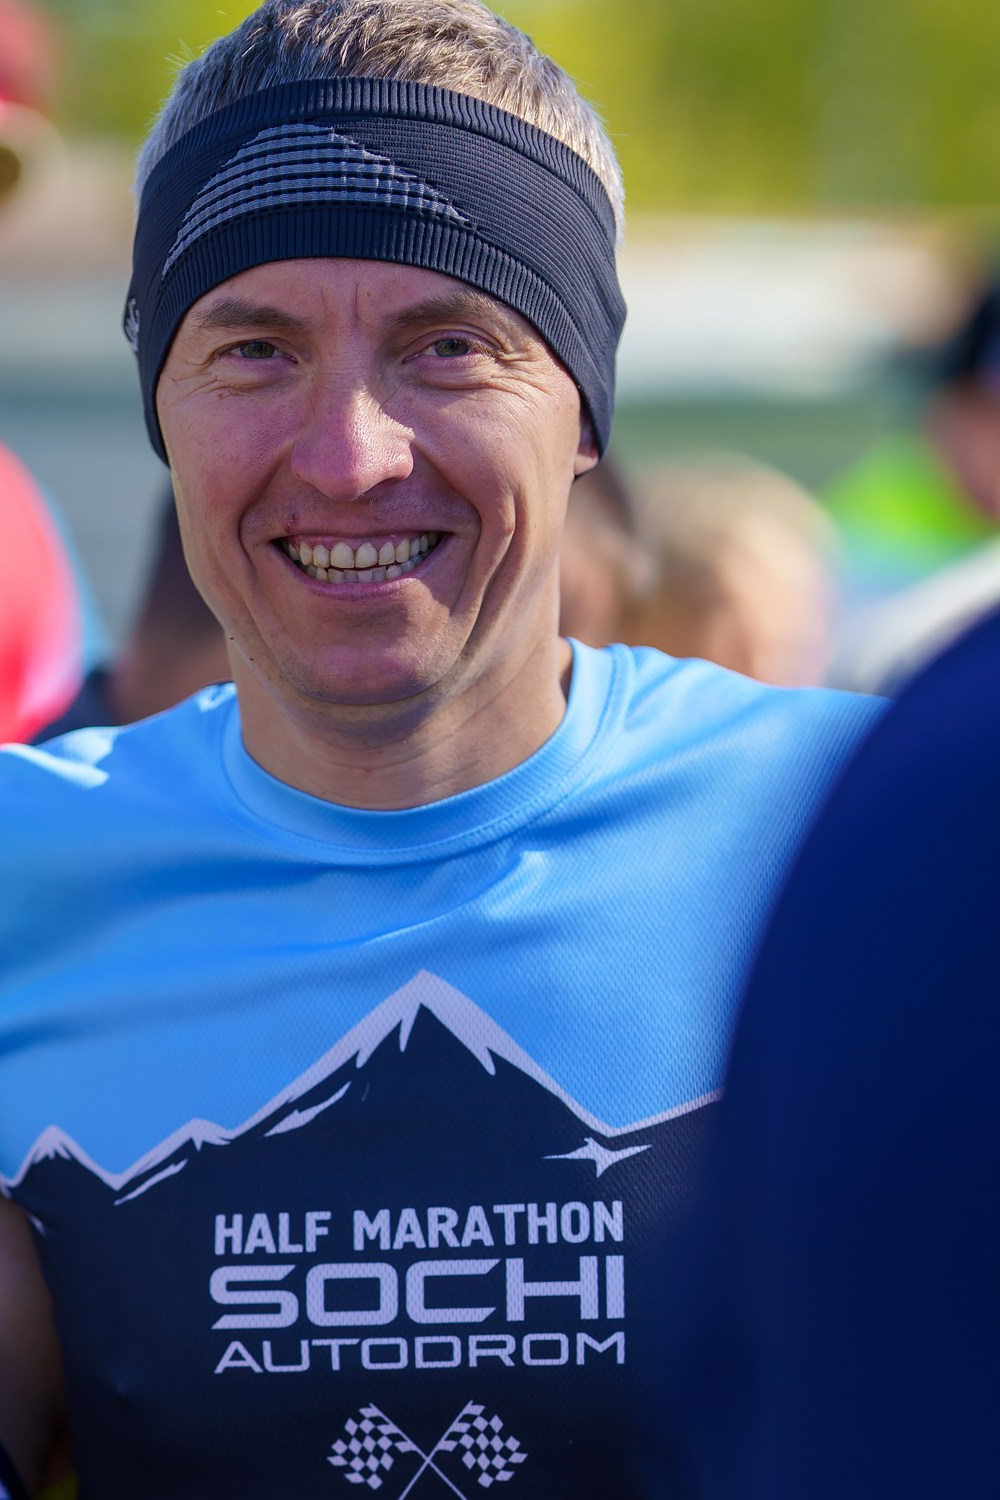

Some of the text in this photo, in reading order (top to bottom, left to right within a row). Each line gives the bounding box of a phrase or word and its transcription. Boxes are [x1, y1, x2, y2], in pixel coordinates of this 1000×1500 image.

[214, 1200, 625, 1255] HALF MARATHON
[209, 1255, 625, 1330] SOCHI
[214, 1331, 626, 1374] AUTODROM
